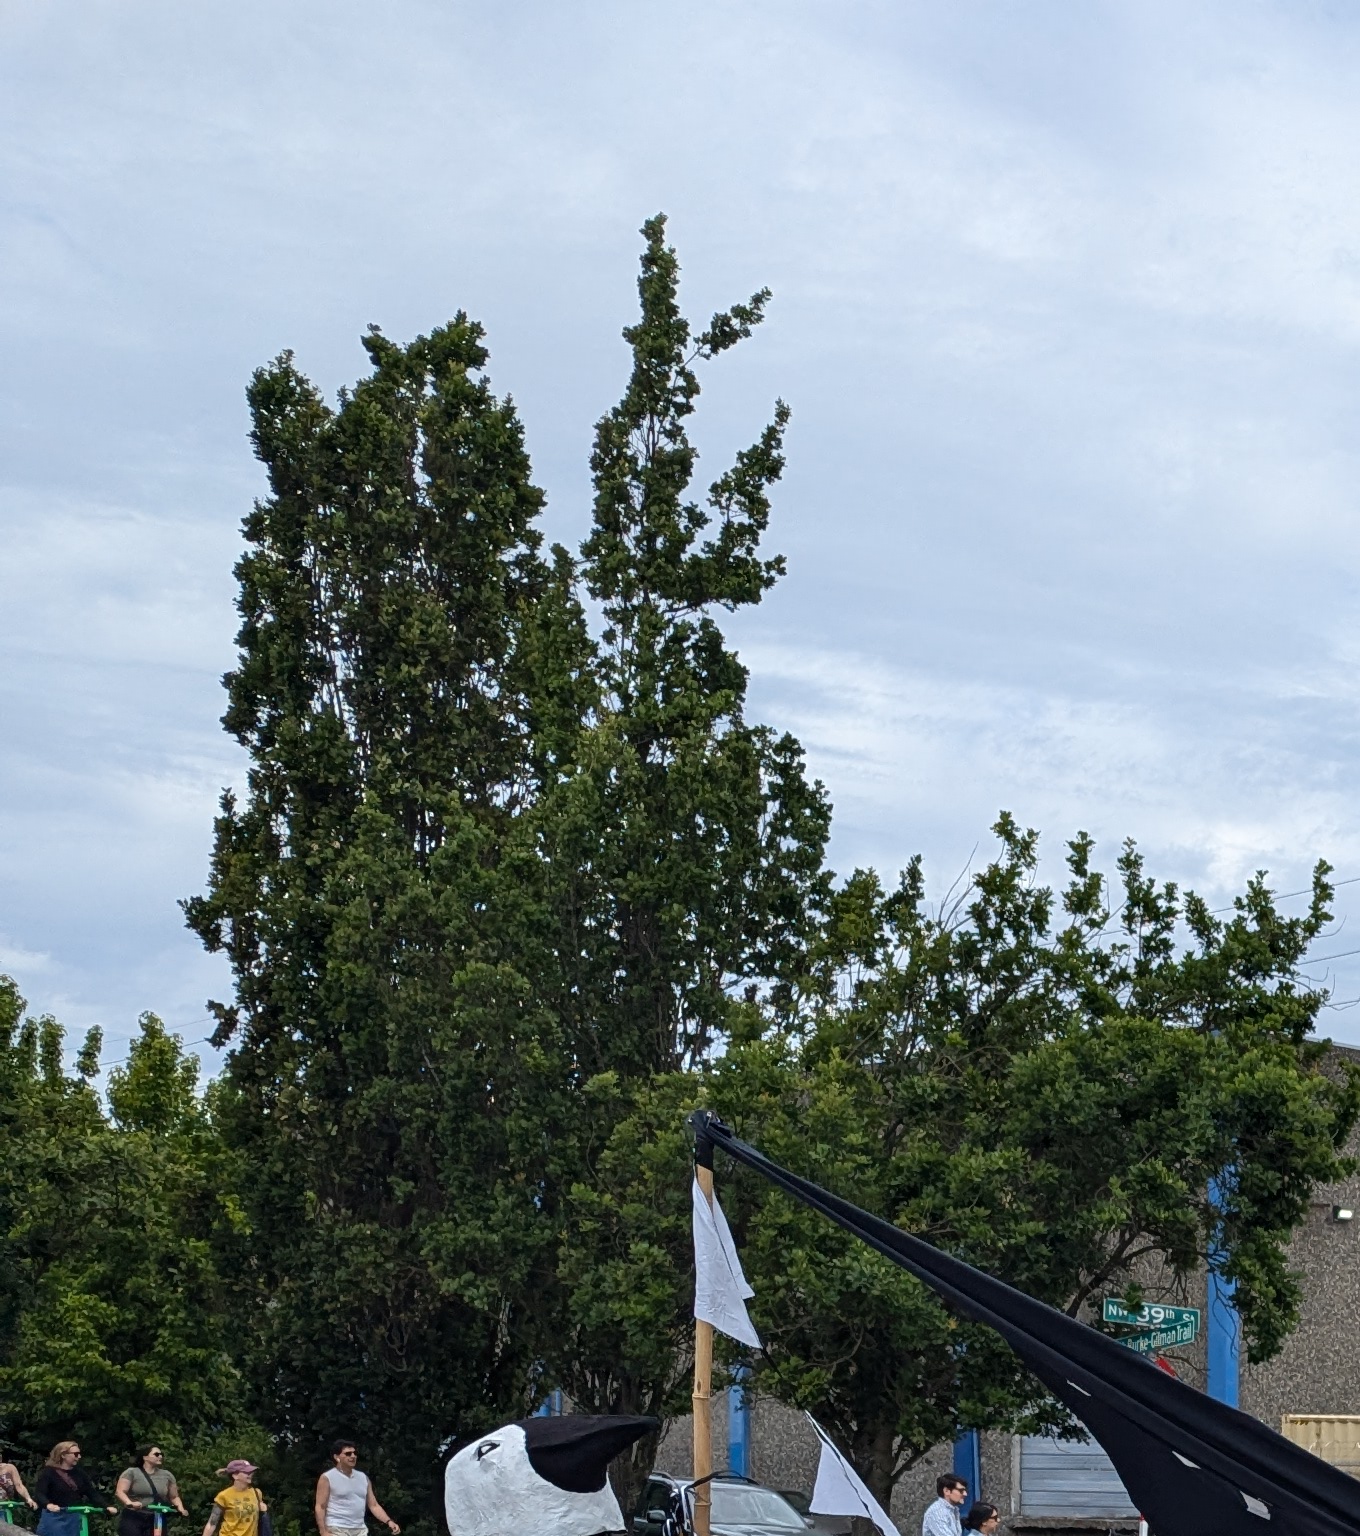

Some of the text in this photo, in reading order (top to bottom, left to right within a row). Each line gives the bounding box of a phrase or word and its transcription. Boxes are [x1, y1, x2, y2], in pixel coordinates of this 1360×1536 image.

[1136, 1305, 1175, 1324] 39th
[1127, 1322, 1192, 1352] Burke-Gilman Trail
